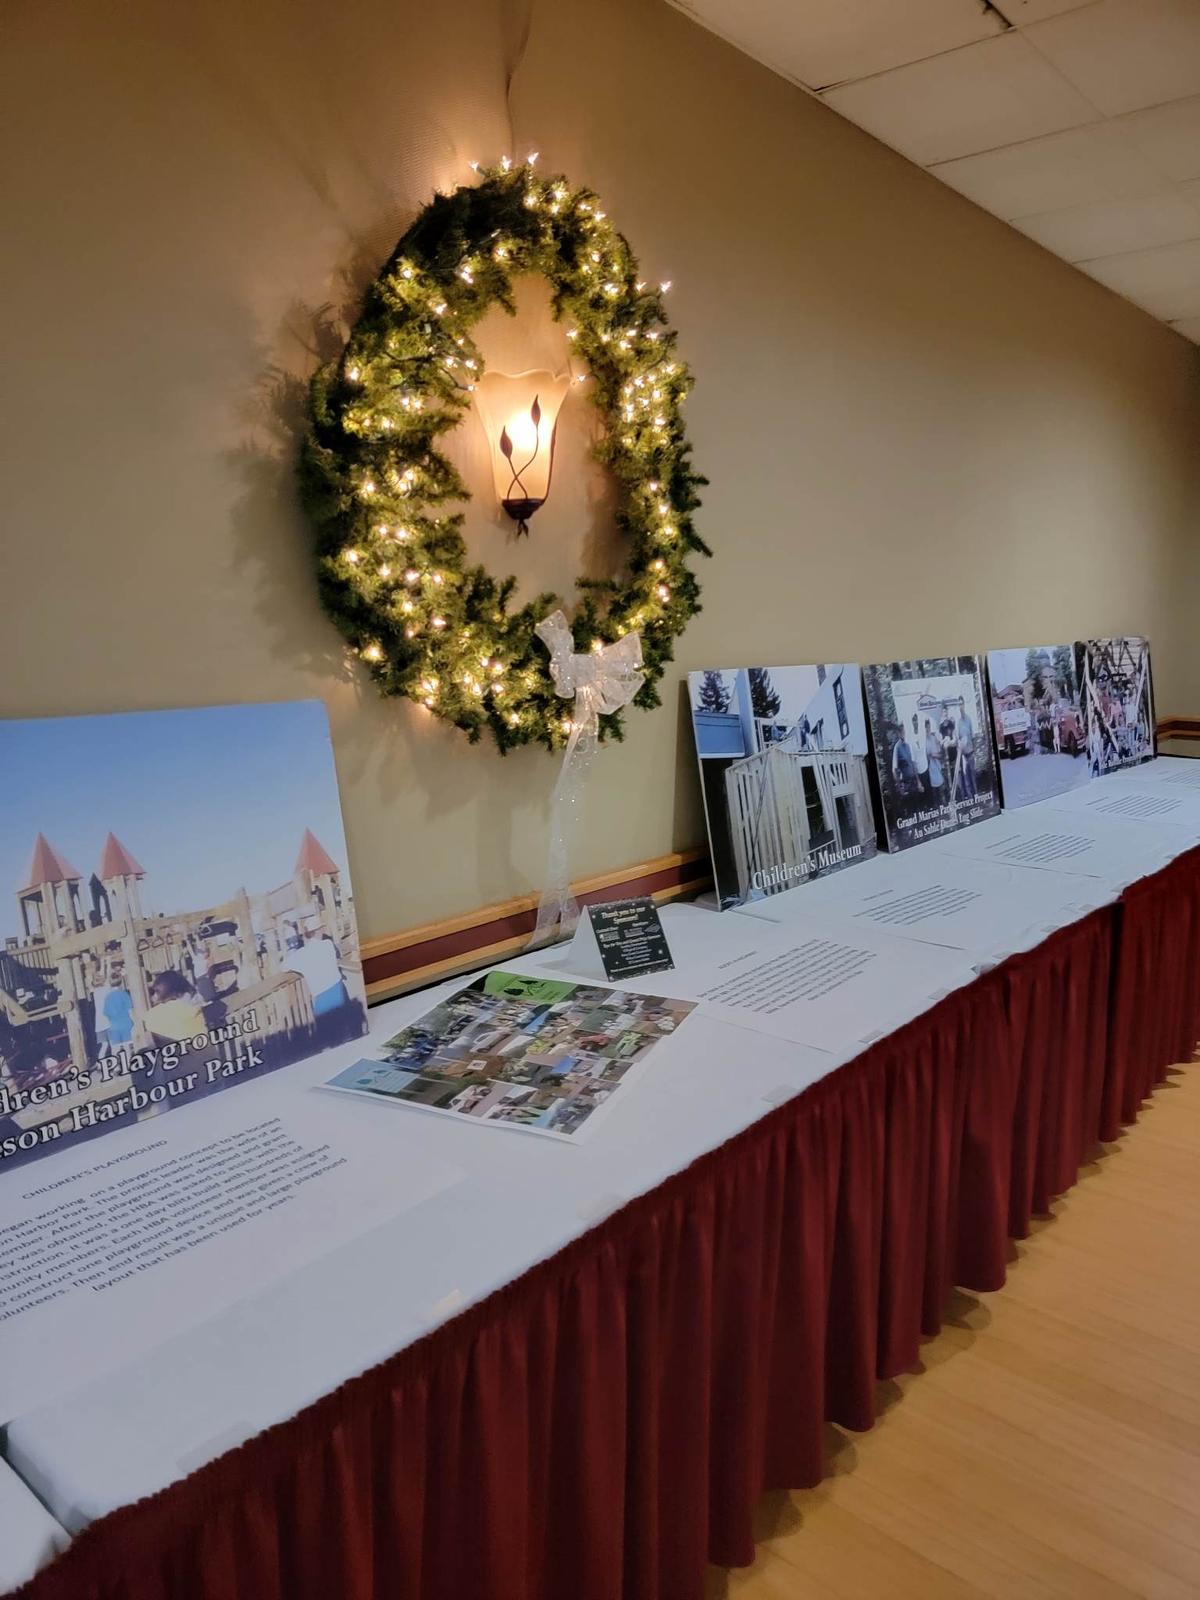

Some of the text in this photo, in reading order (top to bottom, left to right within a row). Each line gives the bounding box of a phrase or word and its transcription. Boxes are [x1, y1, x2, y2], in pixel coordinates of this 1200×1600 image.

[897, 812, 918, 829] Grand
[753, 844, 862, 890] Children's Museum
[99, 1008, 260, 1083] Playground
[0, 1045, 264, 1160] son Harbour Park
[0, 1218, 33, 1236] egan
[35, 1198, 86, 1220] working
[90, 1189, 106, 1199] on
[117, 1158, 177, 1188] playground
[178, 1143, 218, 1162] concept
[16, 1219, 59, 1239] Harbor
[97, 1193, 118, 1205] The
[120, 1178, 157, 1197] project
[160, 1163, 194, 1178] leader
[196, 1155, 217, 1164] was
[217, 1147, 235, 1155] the
[22, 1139, 168, 1200] CHILDREN'S PLAYGROUND
[51, 1220, 82, 1236] After
[85, 1210, 106, 1221] the
[107, 1181, 172, 1213] playground
[174, 1173, 195, 1187] was
[196, 1152, 240, 1175] designed
[242, 1144, 261, 1155] and
[82, 1233, 108, 1245] was
[120, 1217, 144, 1230] one
[145, 1206, 168, 1221] day
[192, 1182, 221, 1197] build
[222, 1172, 246, 1184] with
[246, 1151, 293, 1174] hundreds
[111, 1229, 142, 1245] Each
[142, 1216, 170, 1231] HBA
[171, 1192, 222, 1218] volunteer
[224, 1172, 267, 1194] member
[10, 1271, 75, 1302] construct
[77, 1259, 103, 1273] one
[105, 1226, 174, 1261] playground
[175, 1209, 211, 1228] device
[213, 1198, 234, 1211] and
[235, 1189, 258, 1200] was
[18, 1248, 46, 1260] was
[108, 1211, 130, 1223] the
[131, 1200, 157, 1214] HBA
[158, 1188, 181, 1201] was
[182, 1175, 212, 1191] asked
[71, 1270, 107, 1287] Then
[107, 1257, 133, 1272] end
[135, 1241, 171, 1260] result
[171, 1229, 196, 1241] was
[206, 1206, 246, 1227] unique
[246, 1195, 267, 1207] and
[293, 1157, 348, 1186] playground
[92, 1270, 136, 1292] layout
[136, 1256, 166, 1272] that
[163, 1245, 188, 1258] has
[187, 1231, 219, 1248] been
[219, 1216, 247, 1232] used
[246, 1208, 263, 1219] for
